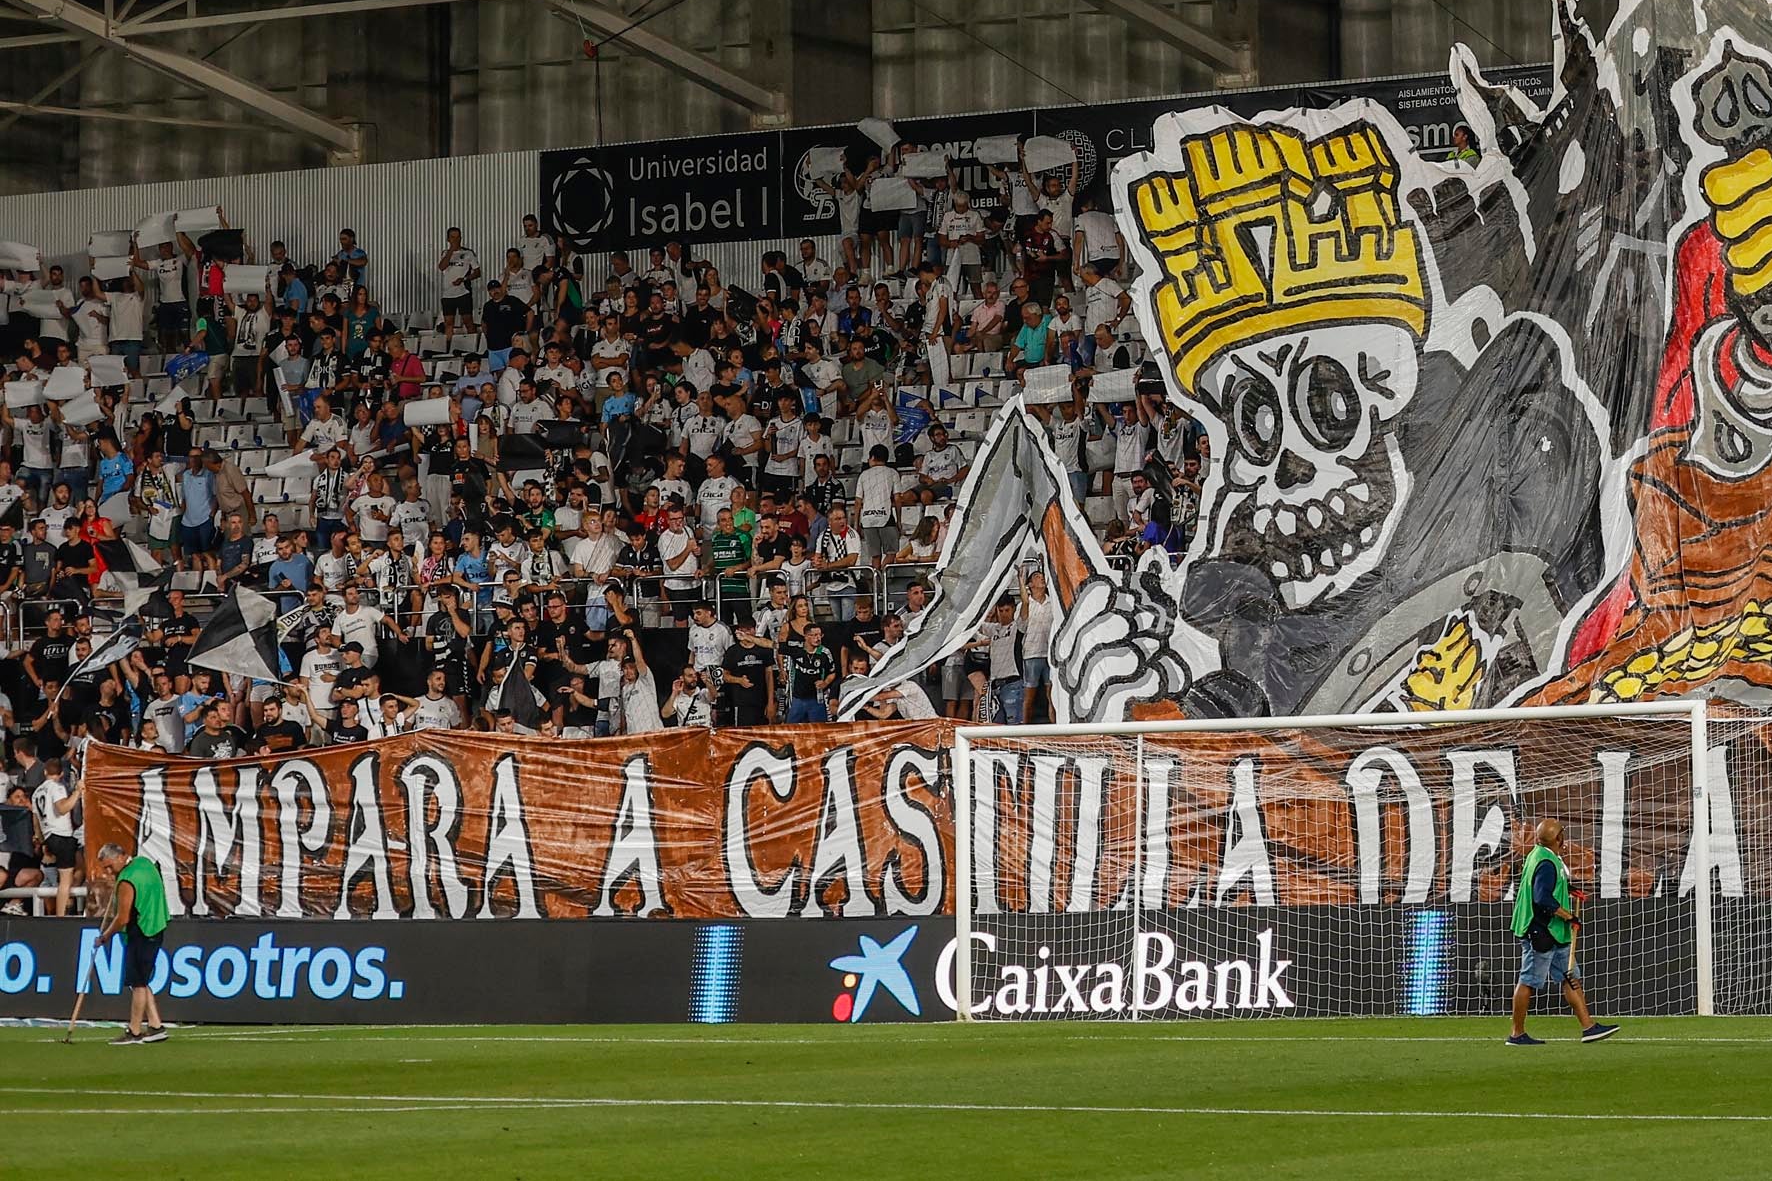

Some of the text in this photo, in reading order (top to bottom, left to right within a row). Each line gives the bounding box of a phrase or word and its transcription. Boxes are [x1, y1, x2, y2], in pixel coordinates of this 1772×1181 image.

[1398, 85, 1456, 99] AISLAMIENTOS
[1398, 98, 1438, 109] SISTEMAS
[628, 149, 768, 181] Universidad
[629, 186, 768, 236] Isabel I
[134, 750, 548, 919] AMPARA
[592, 751, 671, 919] A
[722, 740, 1281, 919] CASTILLA
[1343, 745, 1529, 905] DE
[1594, 744, 1747, 899] LA
[934, 926, 1296, 1014] CaixaBank
